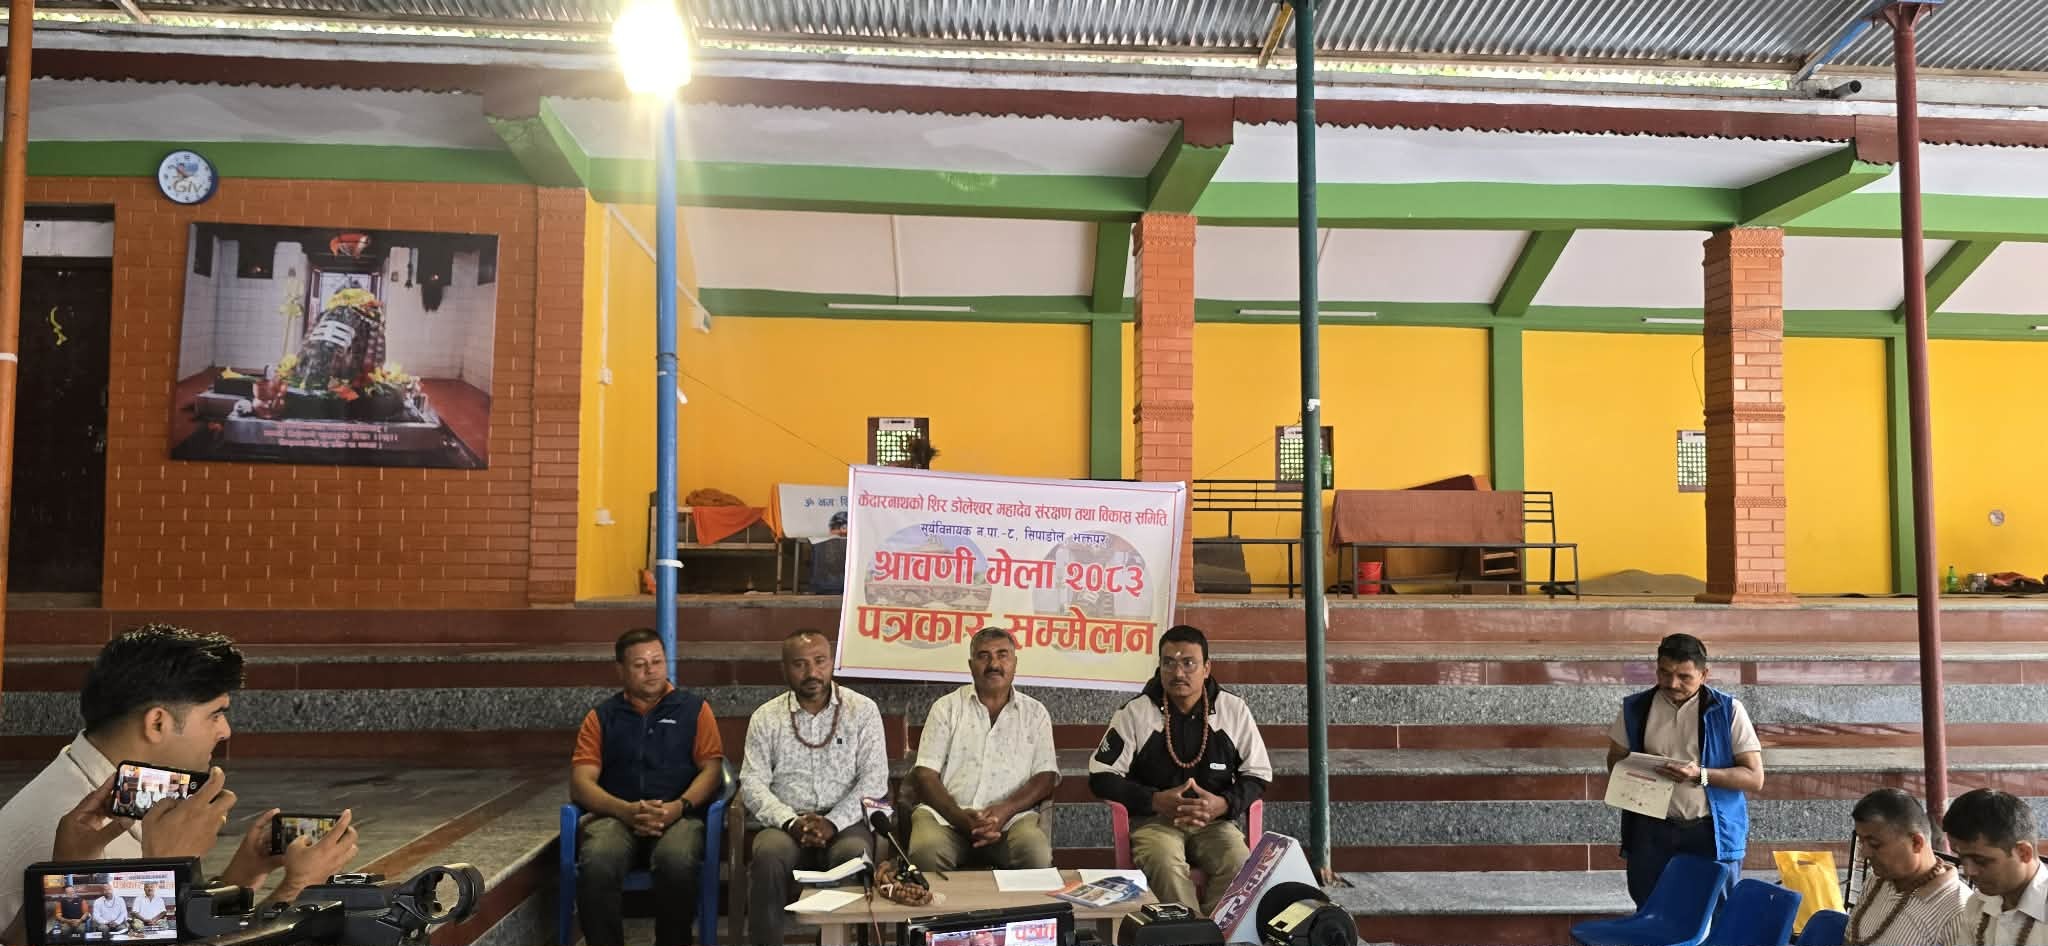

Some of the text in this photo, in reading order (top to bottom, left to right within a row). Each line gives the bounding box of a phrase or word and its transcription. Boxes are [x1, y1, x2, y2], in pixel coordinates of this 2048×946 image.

[858, 490, 924, 511] केदारनाथको
[927, 494, 947, 513] शिर
[951, 497, 993, 516] डोलेश्वर
[997, 500, 1032, 518] महादेव
[1034, 504, 1073, 521] संरक्षण
[1075, 507, 1096, 522] तथा
[1099, 505, 1132, 525] विकास
[874, 546, 1145, 598] श्रावणी मेला २०८३
[857, 605, 1158, 655] पत्रकार सम्मेलन
